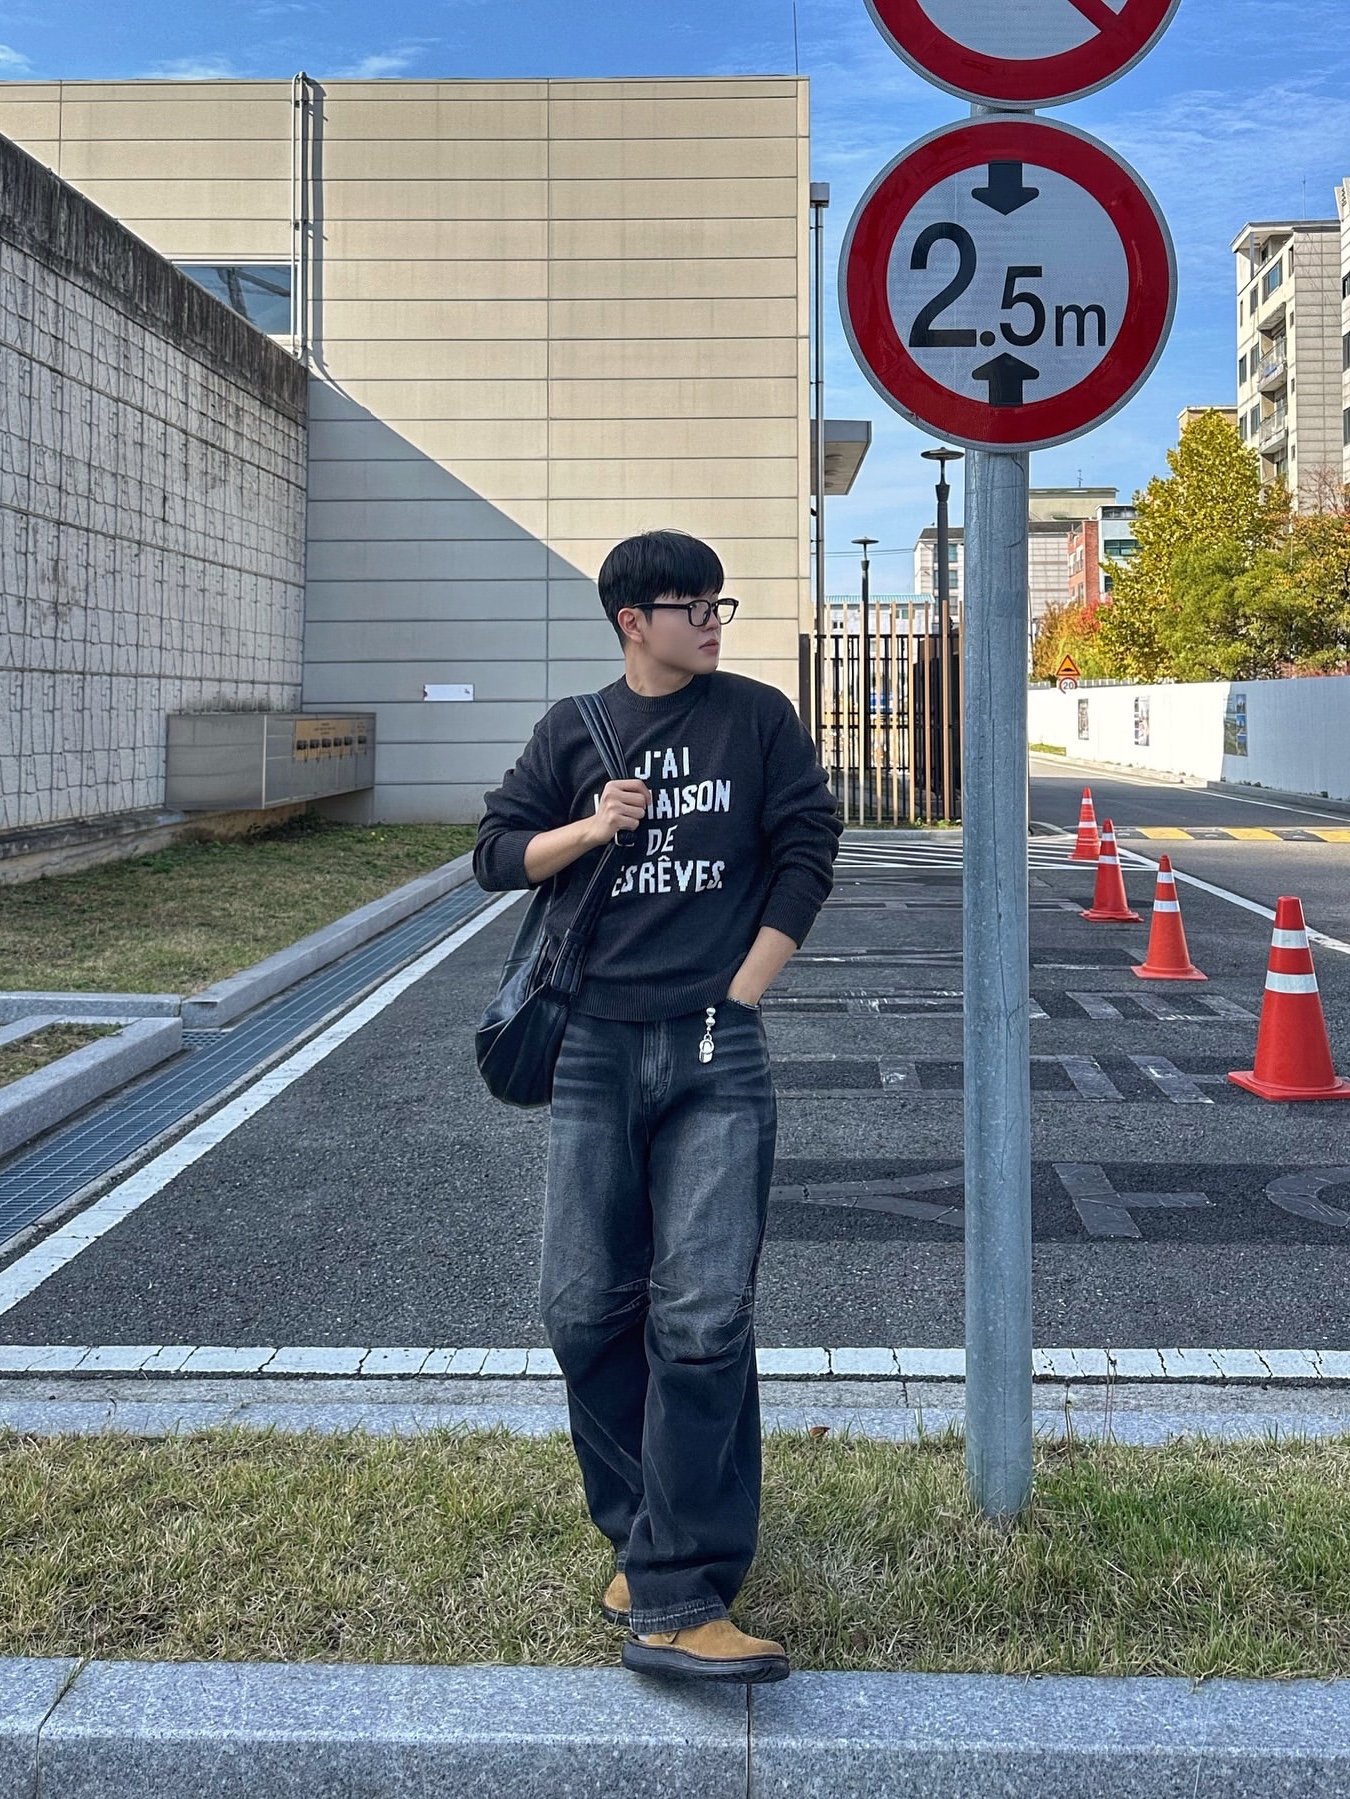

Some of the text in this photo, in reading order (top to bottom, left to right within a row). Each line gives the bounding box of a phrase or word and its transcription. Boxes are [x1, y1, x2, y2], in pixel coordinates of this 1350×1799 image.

[1063, 681, 1074, 690] 20
[634, 746, 690, 780] J'AI
[646, 824, 678, 856] DE
